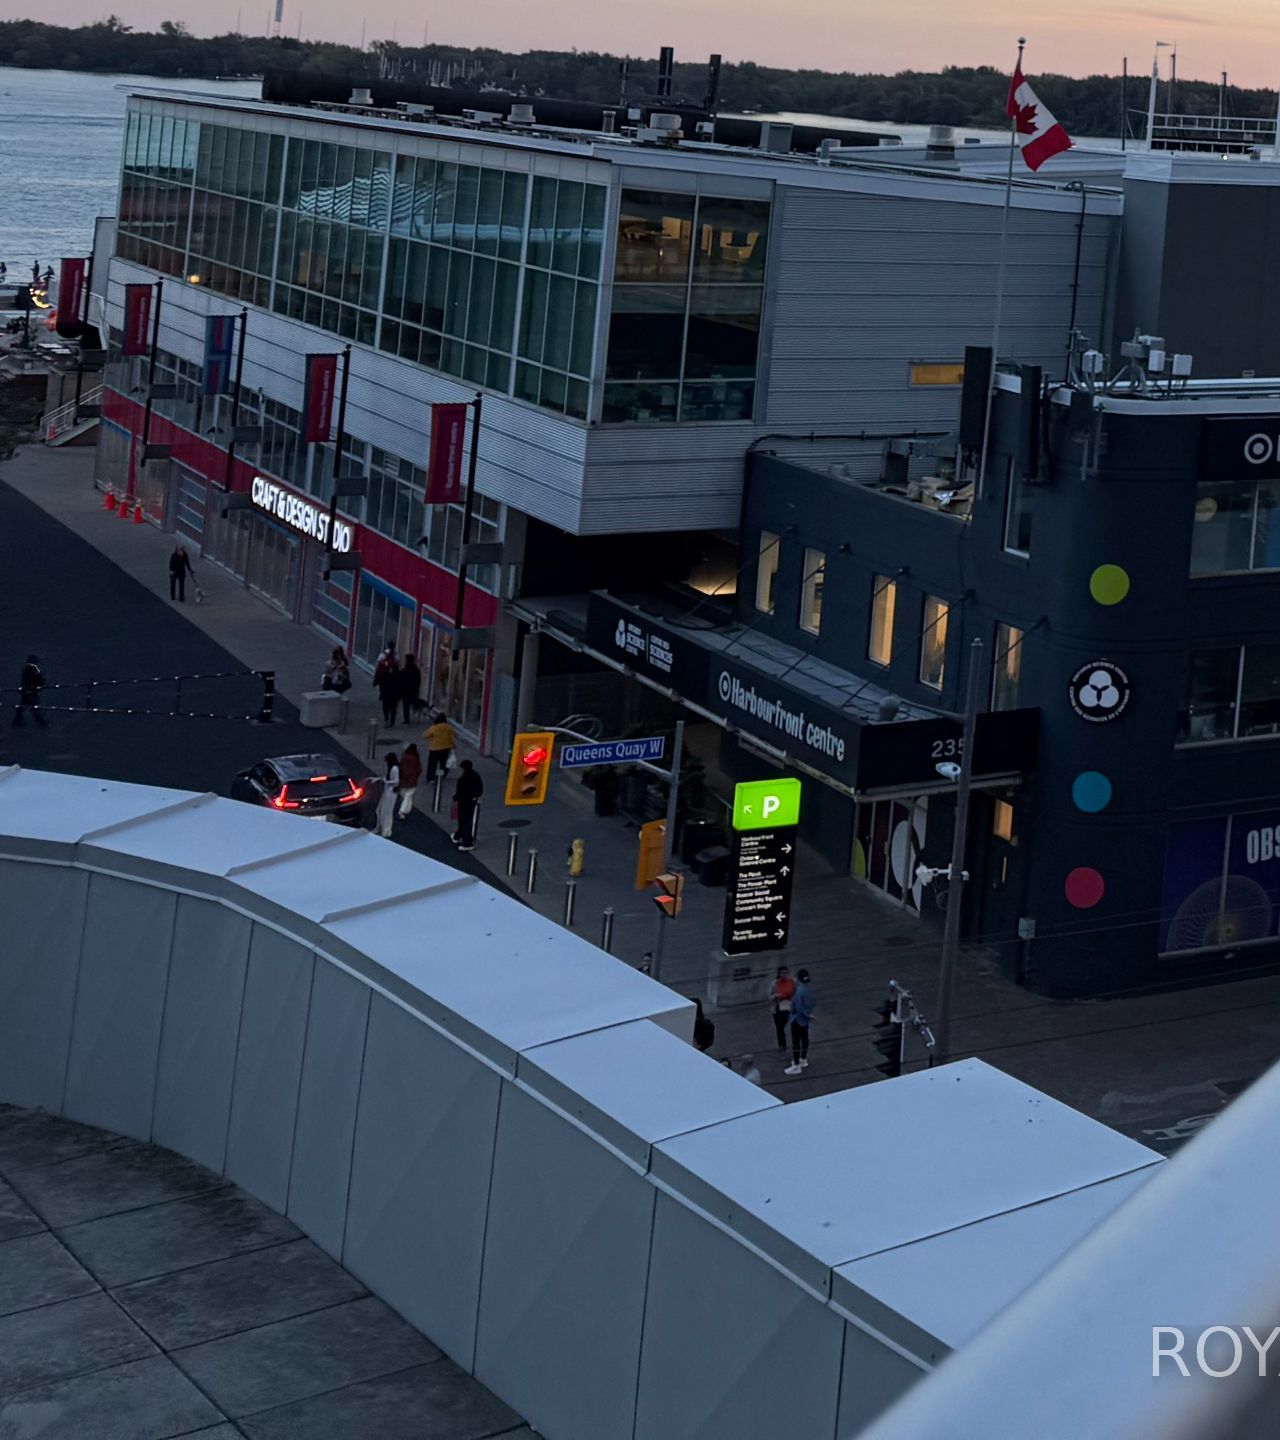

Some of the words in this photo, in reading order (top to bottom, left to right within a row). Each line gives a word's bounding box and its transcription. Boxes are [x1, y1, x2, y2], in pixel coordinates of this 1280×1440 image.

[252, 476, 279, 514] CRAFT
[285, 494, 318, 538] DESIGN
[316, 512, 350, 553] STDIO
[731, 677, 805, 740] Harbourfront
[806, 722, 845, 762] centre
[565, 747, 612, 763] Queens
[615, 743, 646, 757] Quay
[649, 740, 660, 753] W
[763, 795, 780, 819] P
